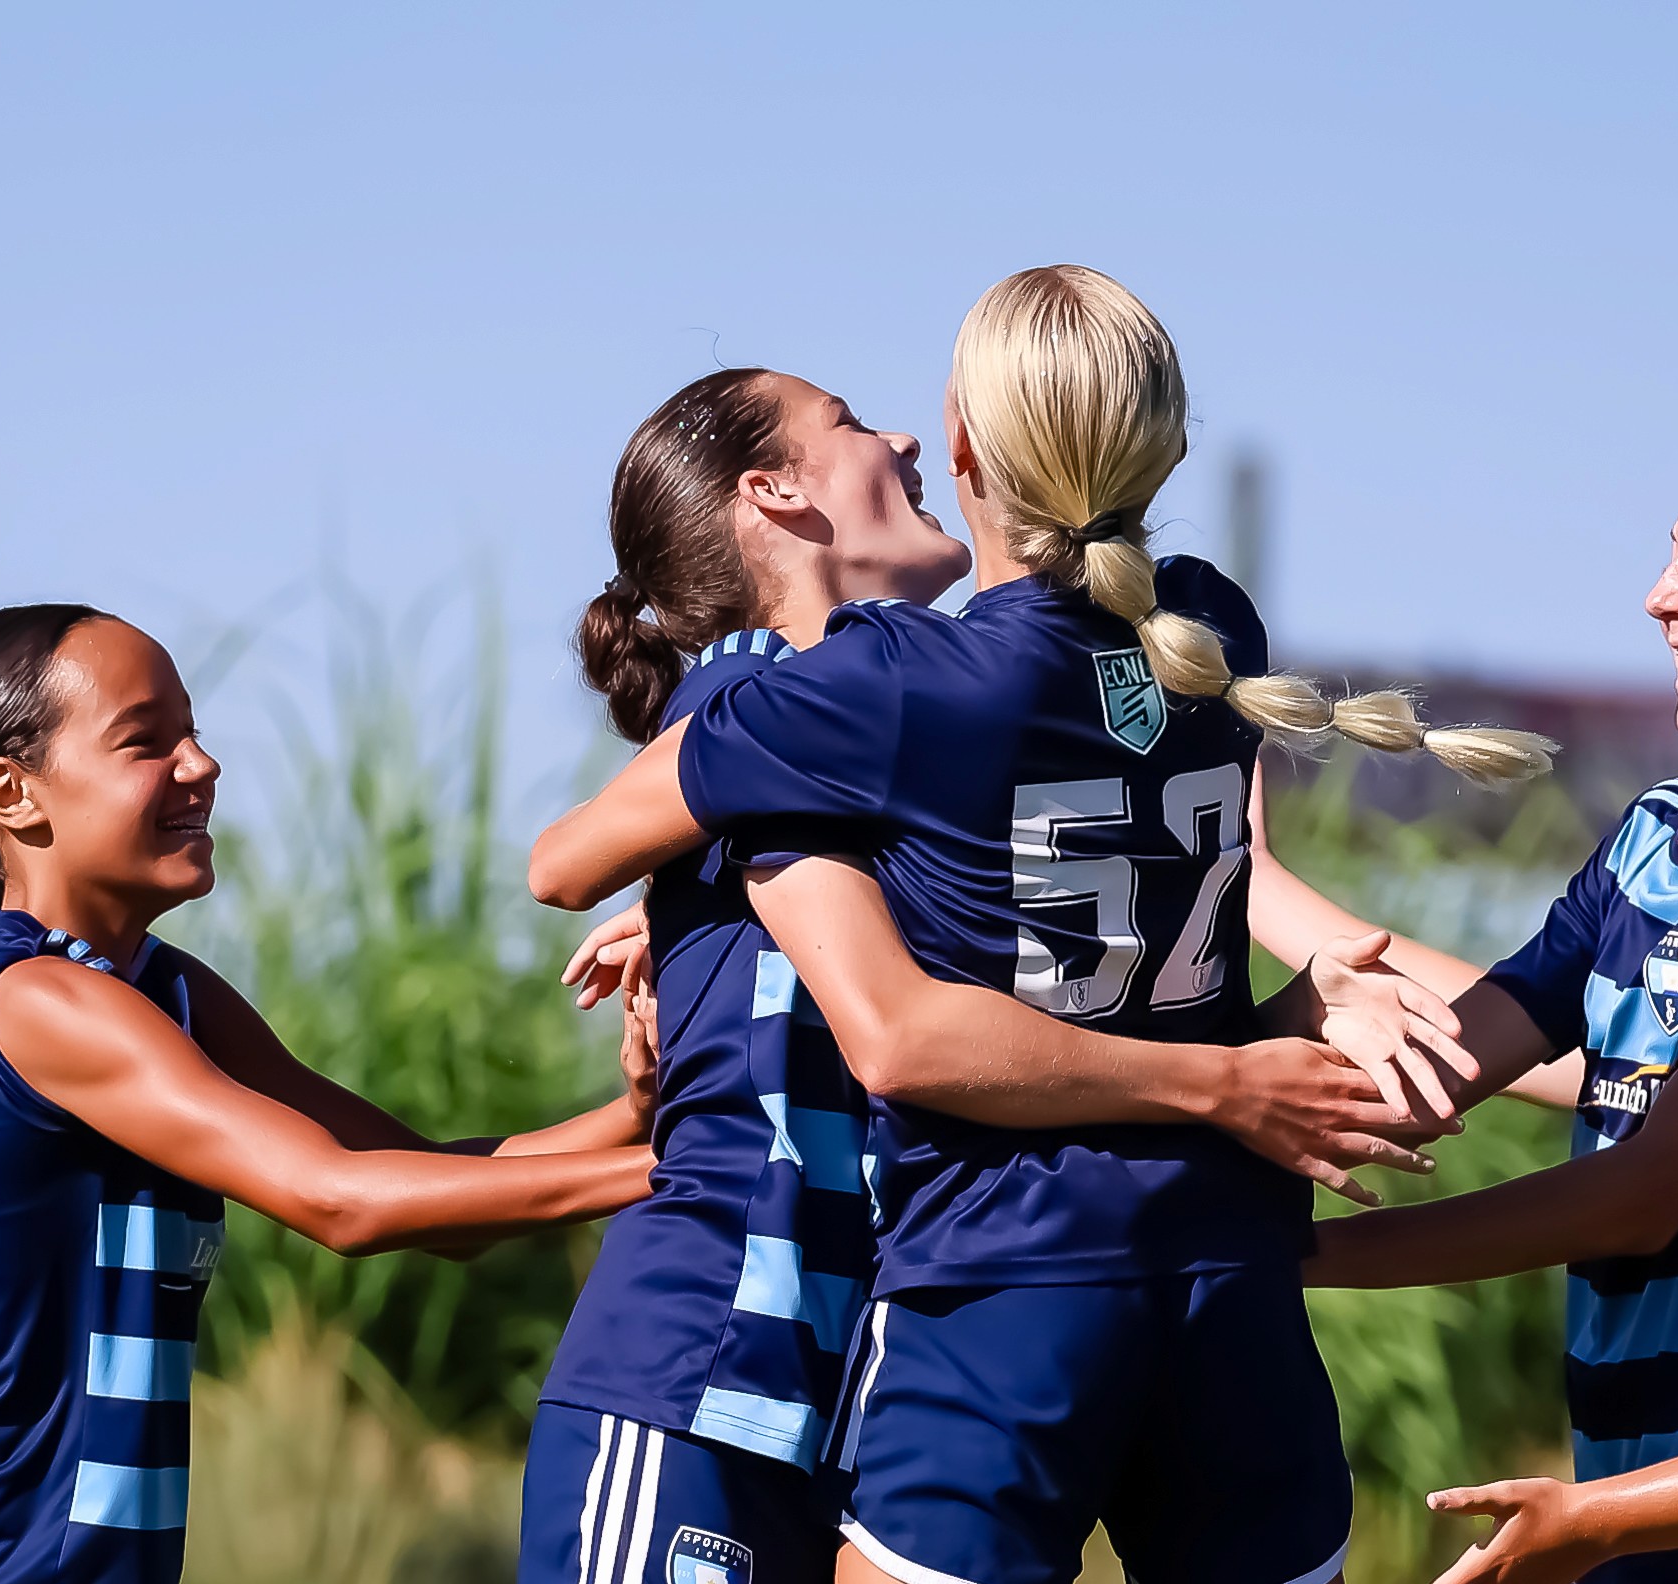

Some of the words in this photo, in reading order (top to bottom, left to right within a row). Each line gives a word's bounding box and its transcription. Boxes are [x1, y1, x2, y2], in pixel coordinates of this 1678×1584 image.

[1100, 655, 1153, 688] ECNL
[1011, 763, 1249, 1020] 52
[682, 1531, 749, 1563] SPORTING
[694, 1547, 739, 1568] IOWA
